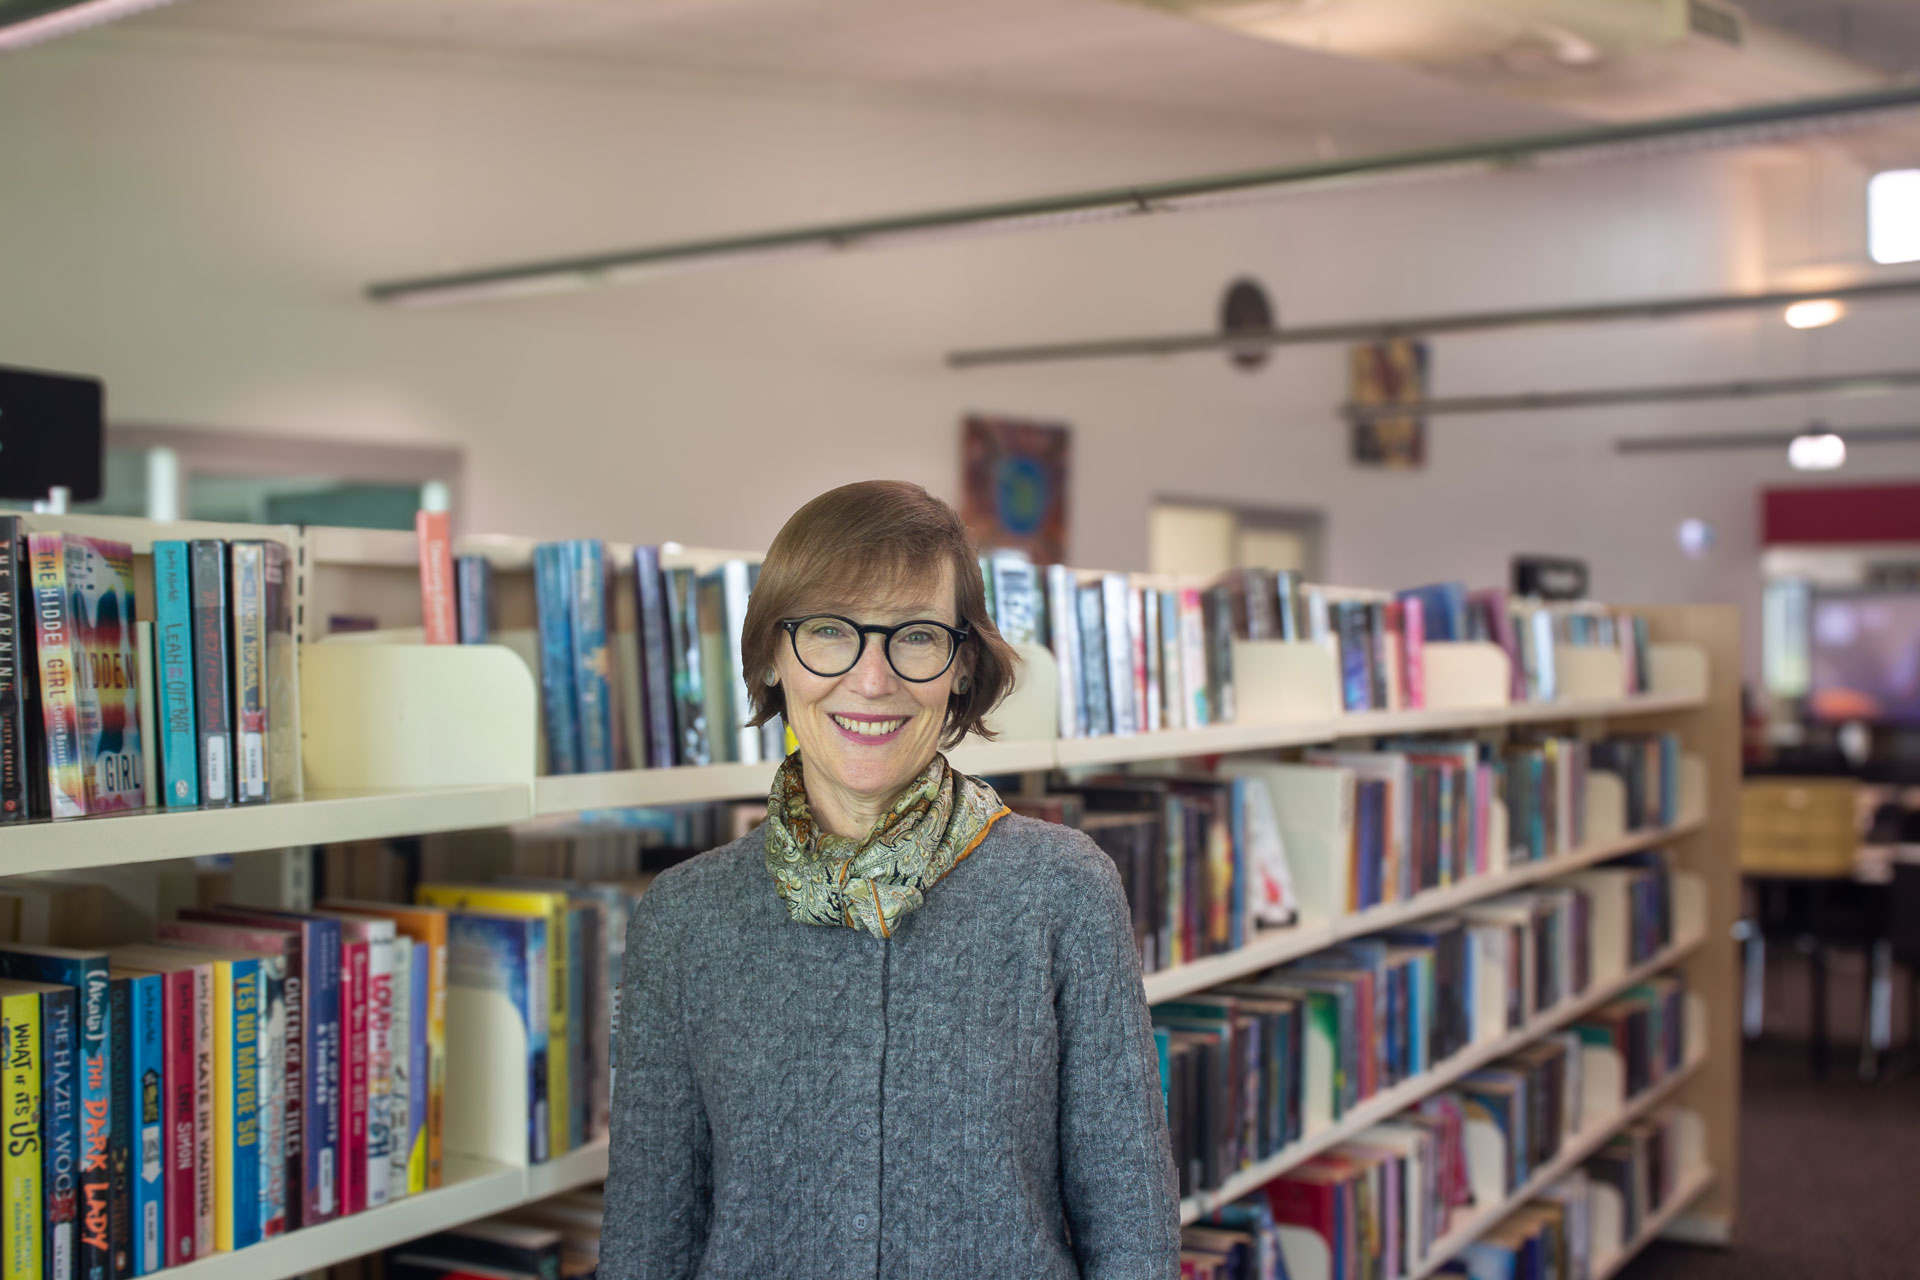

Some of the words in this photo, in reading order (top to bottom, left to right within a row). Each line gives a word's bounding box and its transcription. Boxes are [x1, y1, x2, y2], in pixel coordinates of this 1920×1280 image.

[38, 550, 57, 581] THE
[166, 623, 184, 664] LEAH
[47, 658, 66, 699] GIRL
[105, 754, 141, 792] GIRL
[236, 973, 257, 1010] YES
[55, 1006, 69, 1044] THE
[236, 1013, 257, 1043] NO
[13, 1023, 31, 1070] WHAT
[15, 1075, 25, 1086] IF
[54, 1049, 71, 1126] HAZEL
[88, 1055, 104, 1089] THE
[198, 1052, 210, 1104] KATE
[236, 1046, 257, 1117] MAYBE
[9, 1123, 38, 1157] US
[83, 1099, 109, 1172] DARK
[198, 1110, 210, 1132] IN
[236, 1118, 257, 1147] SO
[177, 1121, 192, 1170] SIMON
[198, 1138, 210, 1217] WAITING
[82, 1182, 110, 1251] LADY
